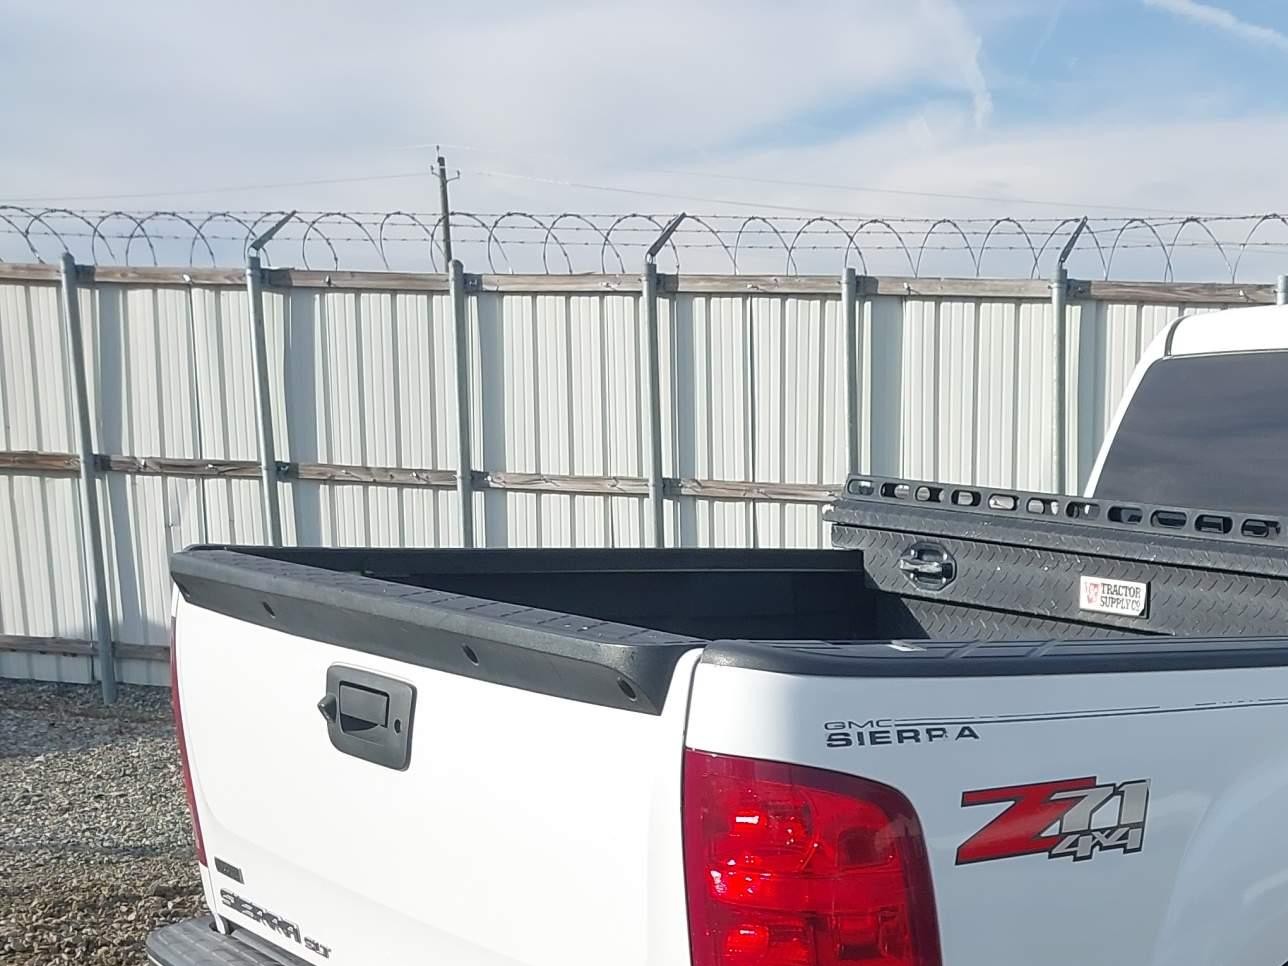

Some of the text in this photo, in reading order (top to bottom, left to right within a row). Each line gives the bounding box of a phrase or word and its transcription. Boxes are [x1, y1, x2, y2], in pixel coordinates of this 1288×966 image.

[1100, 582, 1141, 599] TRACTOR
[1100, 595, 1131, 610] SUPPLY
[823, 719, 893, 731] GMC
[826, 726, 980, 748] SIERRA
[955, 775, 1151, 866] Z71
[220, 888, 302, 945] SIERRA
[304, 936, 331, 959] SLT
